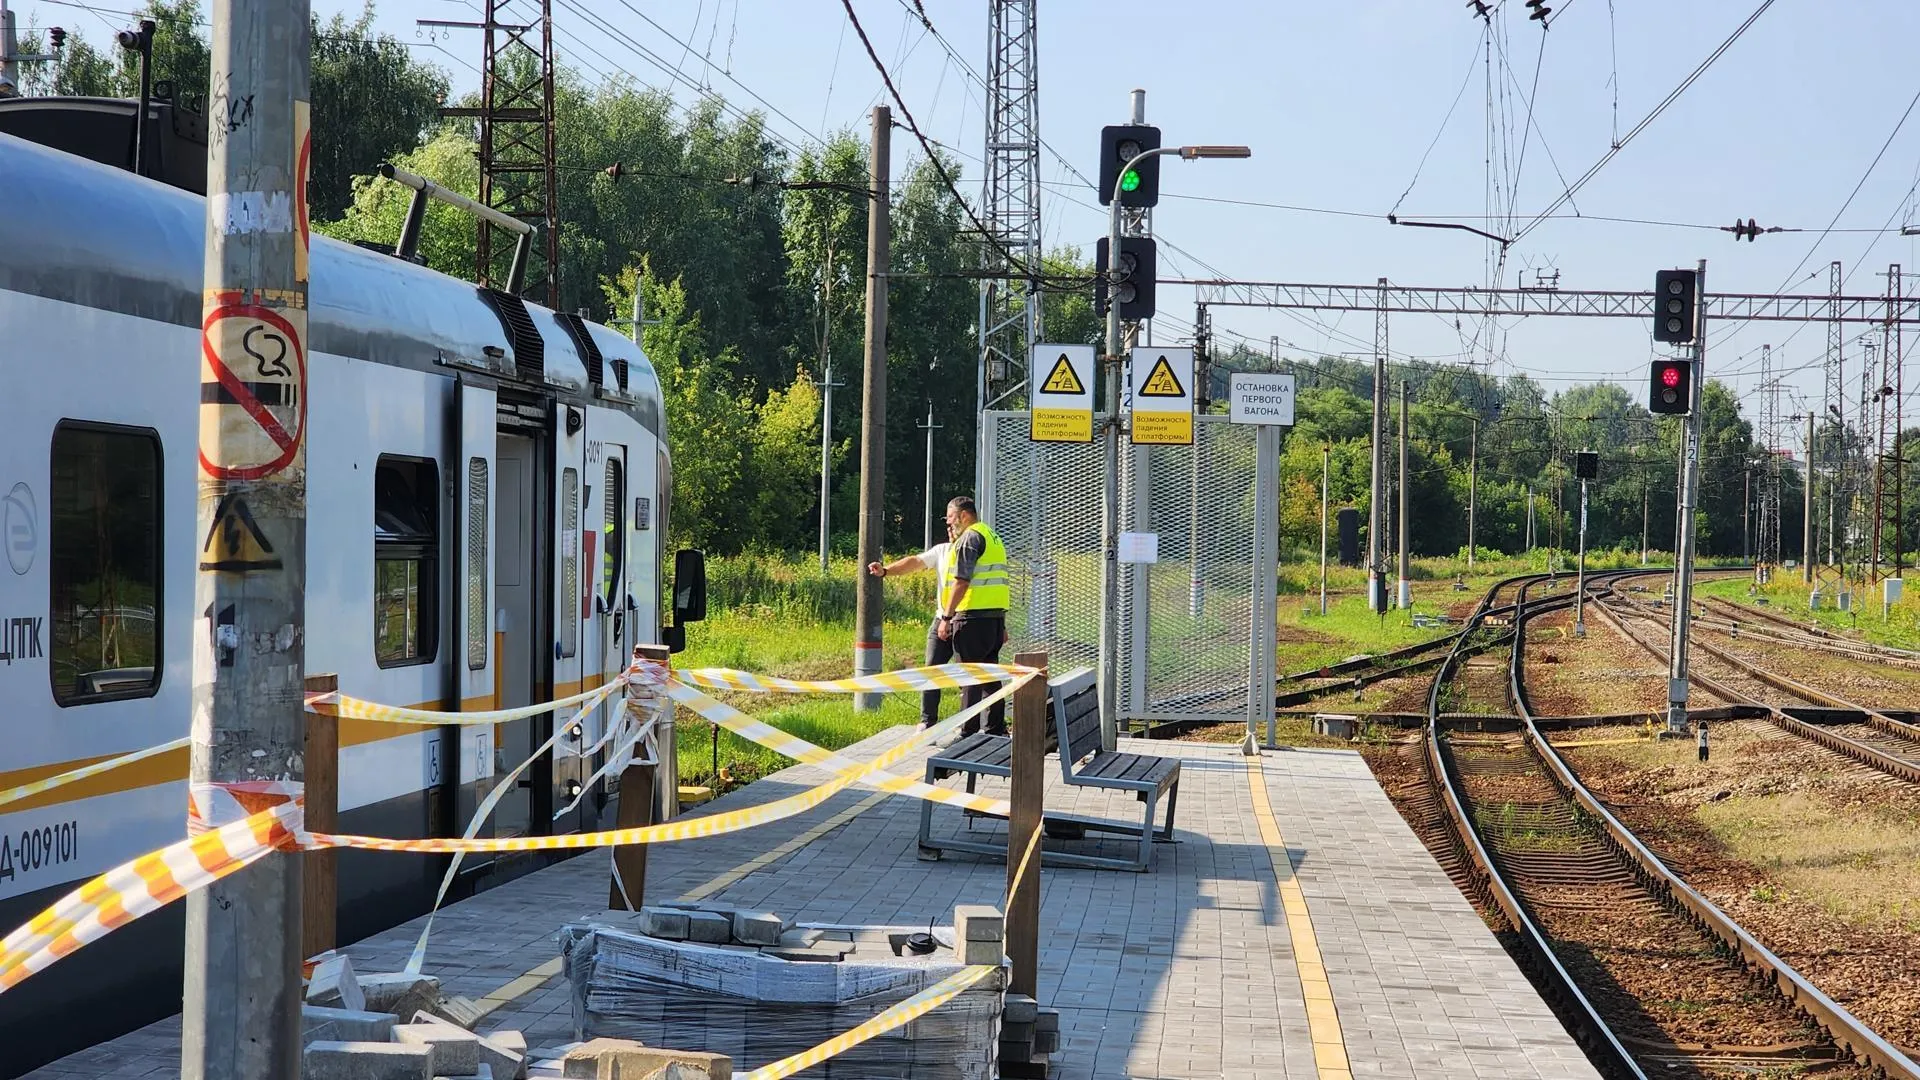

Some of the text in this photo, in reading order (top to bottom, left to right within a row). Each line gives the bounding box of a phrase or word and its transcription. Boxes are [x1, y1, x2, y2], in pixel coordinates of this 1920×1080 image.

[1236, 383, 1289, 393] ОСТАНОВКА
[1242, 395, 1282, 404] ПЕРВОГО
[1036, 412, 1086, 420] Возможность
[1244, 407, 1279, 416] ВАГОНА
[0, 617, 43, 666] ЦППК
[0, 821, 77, 884] Д-009101
